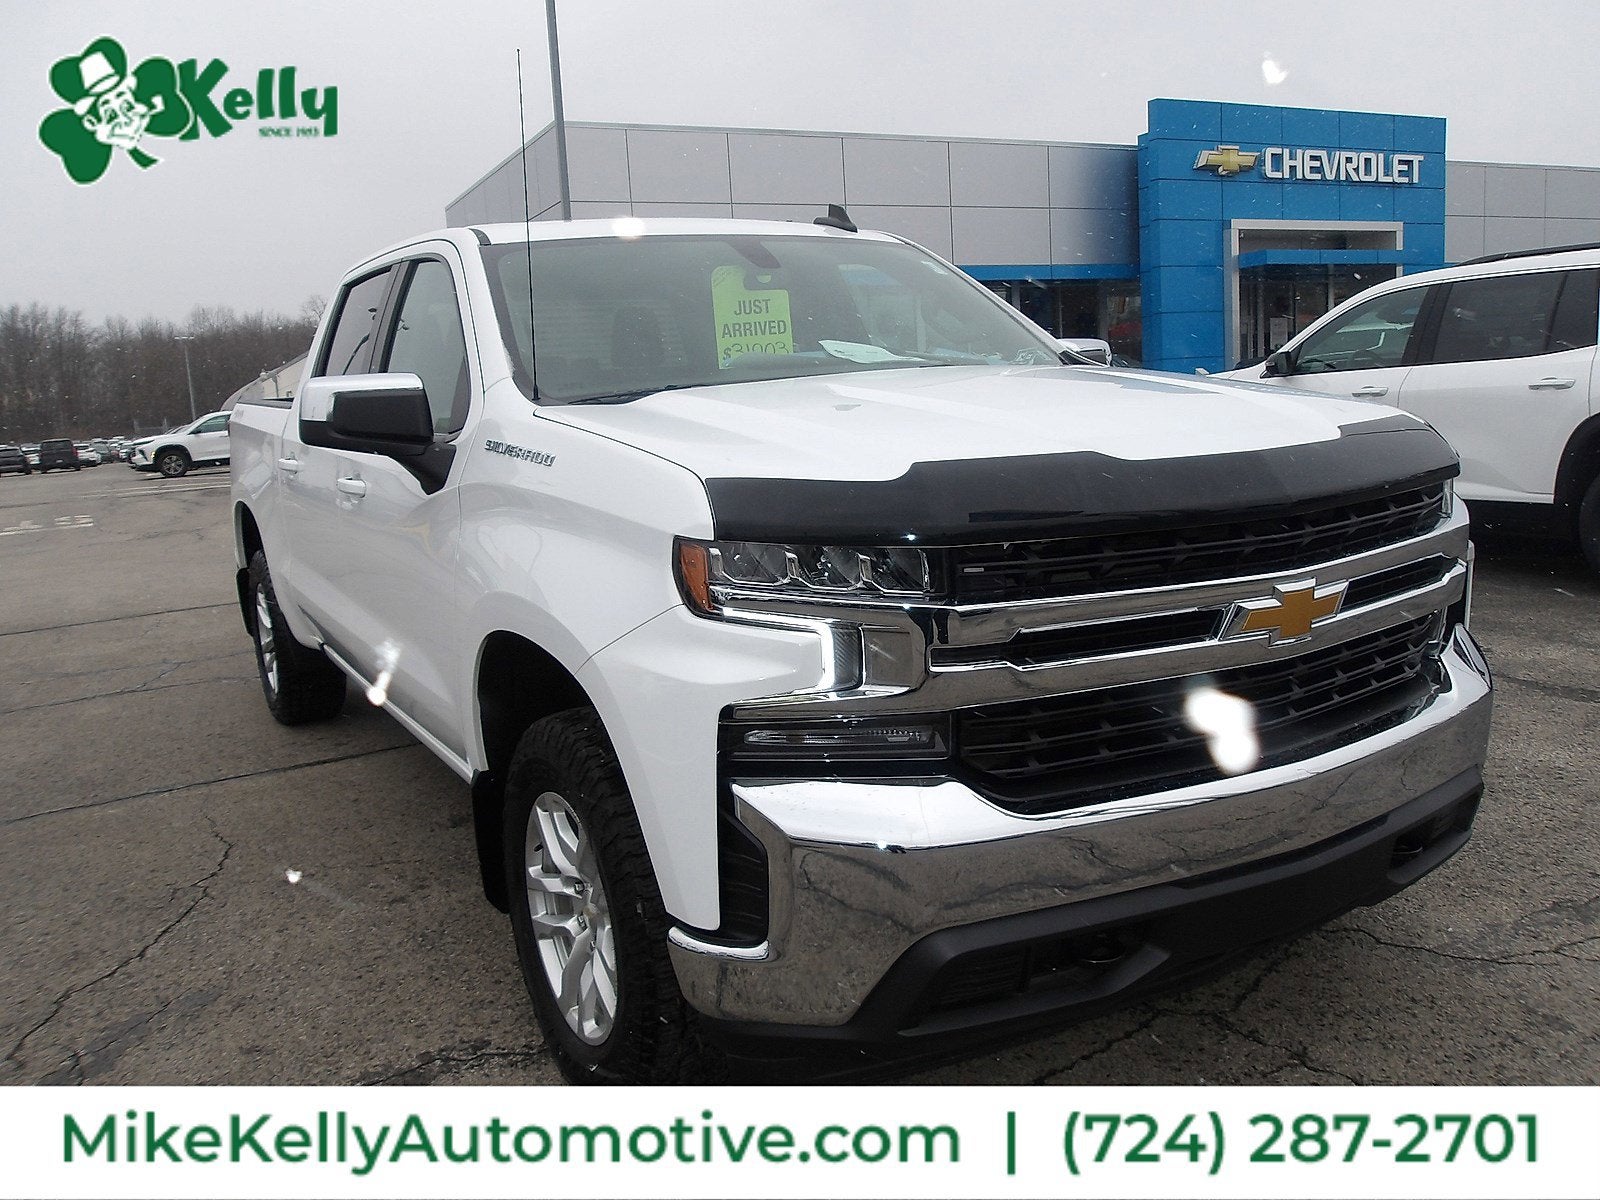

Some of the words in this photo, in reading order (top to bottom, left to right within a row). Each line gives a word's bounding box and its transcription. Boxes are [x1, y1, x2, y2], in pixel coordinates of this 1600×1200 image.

[1264, 147, 1424, 184] CHEVROLET
[734, 298, 771, 316] JUST
[721, 320, 787, 338] ARRIVED
[484, 439, 556, 467] SILVERADO
